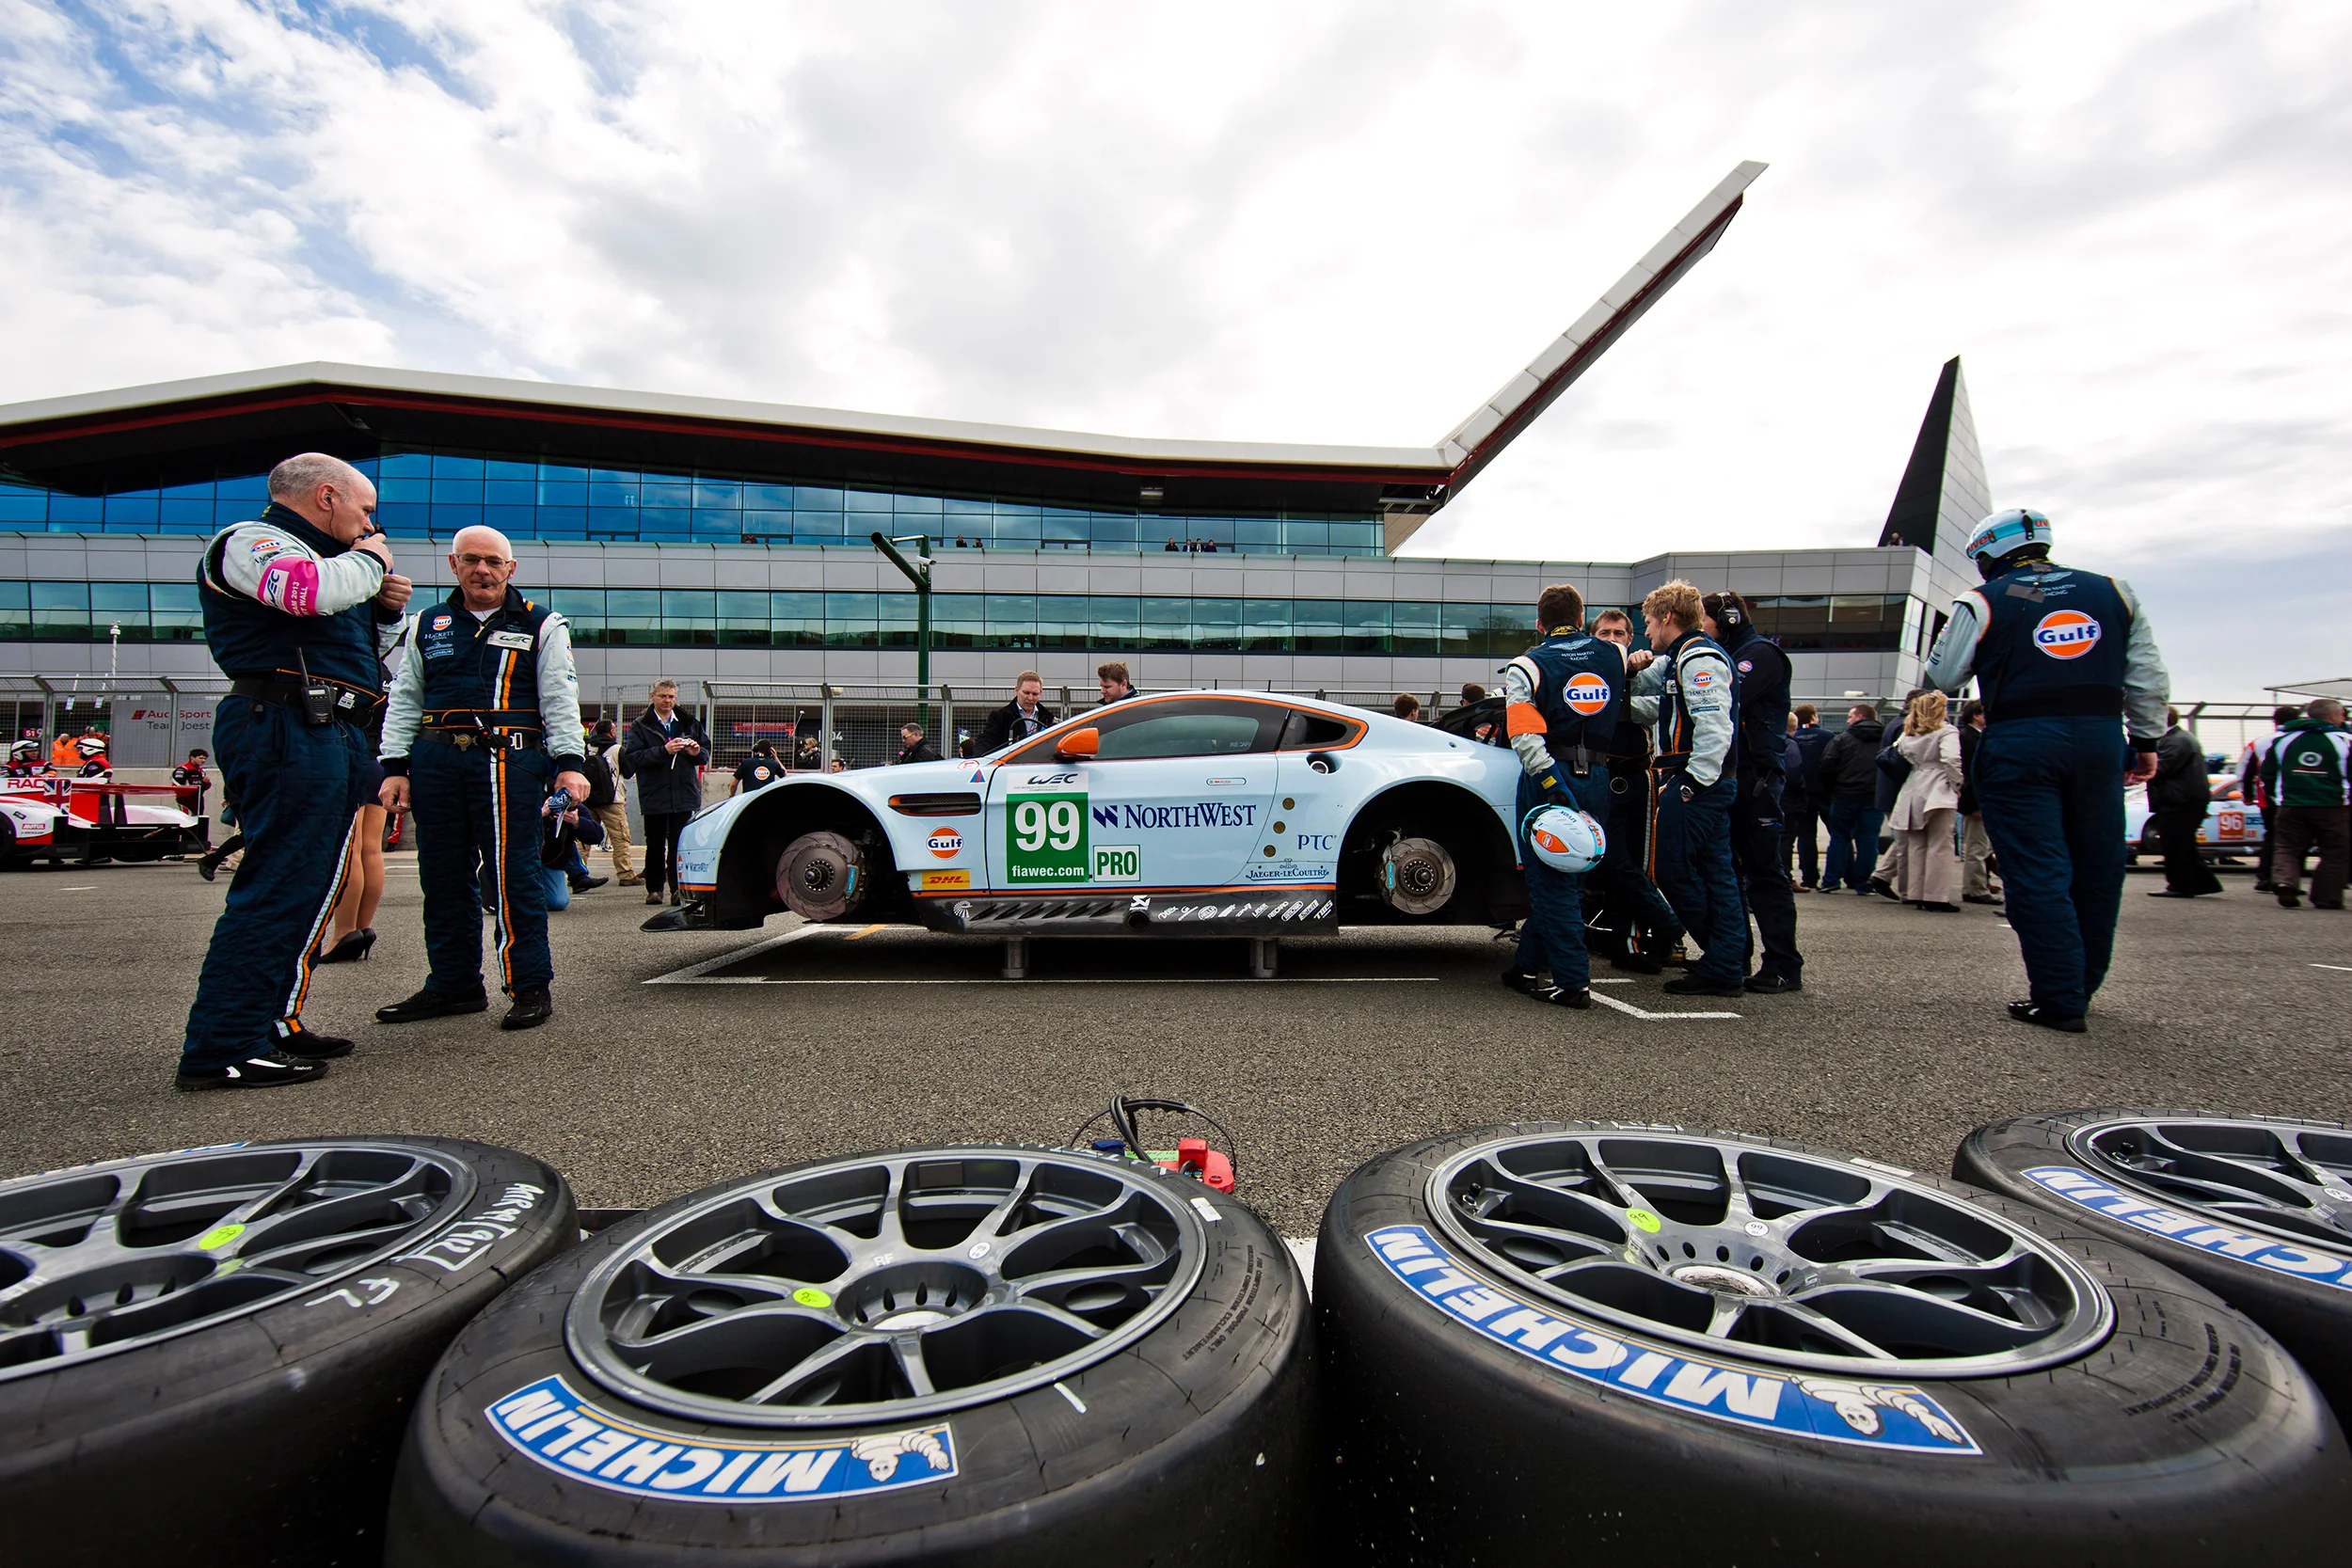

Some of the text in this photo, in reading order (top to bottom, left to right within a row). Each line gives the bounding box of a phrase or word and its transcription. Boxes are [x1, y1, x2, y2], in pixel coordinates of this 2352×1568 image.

[292, 581, 300, 599] 2013
[300, 586, 309, 607] WALL
[2038, 626, 2097, 644] Gulf
[1566, 688, 1608, 701] Gulf
[180, 710, 212, 721] Sport
[25, 729, 36, 737] 51
[181, 721, 211, 730] Joest
[1027, 773, 1078, 785] WEC
[1014, 800, 1080, 852] 99
[2219, 815, 2243, 831] 96
[928, 838, 962, 848] Gulf
[1011, 865, 1084, 877] fiawec.com
[1097, 850, 1137, 876] PRO
[930, 876, 963, 884] DHL
[1629, 1212, 1651, 1224] 99
[2030, 1170, 2352, 1287] CHELIN
[873, 1253, 894, 1267] RF
[1225, 1307, 1249, 1335] PURPOSE
[1373, 1232, 1785, 1421] MICHELIN
[1207, 1335, 1227, 1354] ONLY
[497, 1388, 843, 1494] MICHELIN
